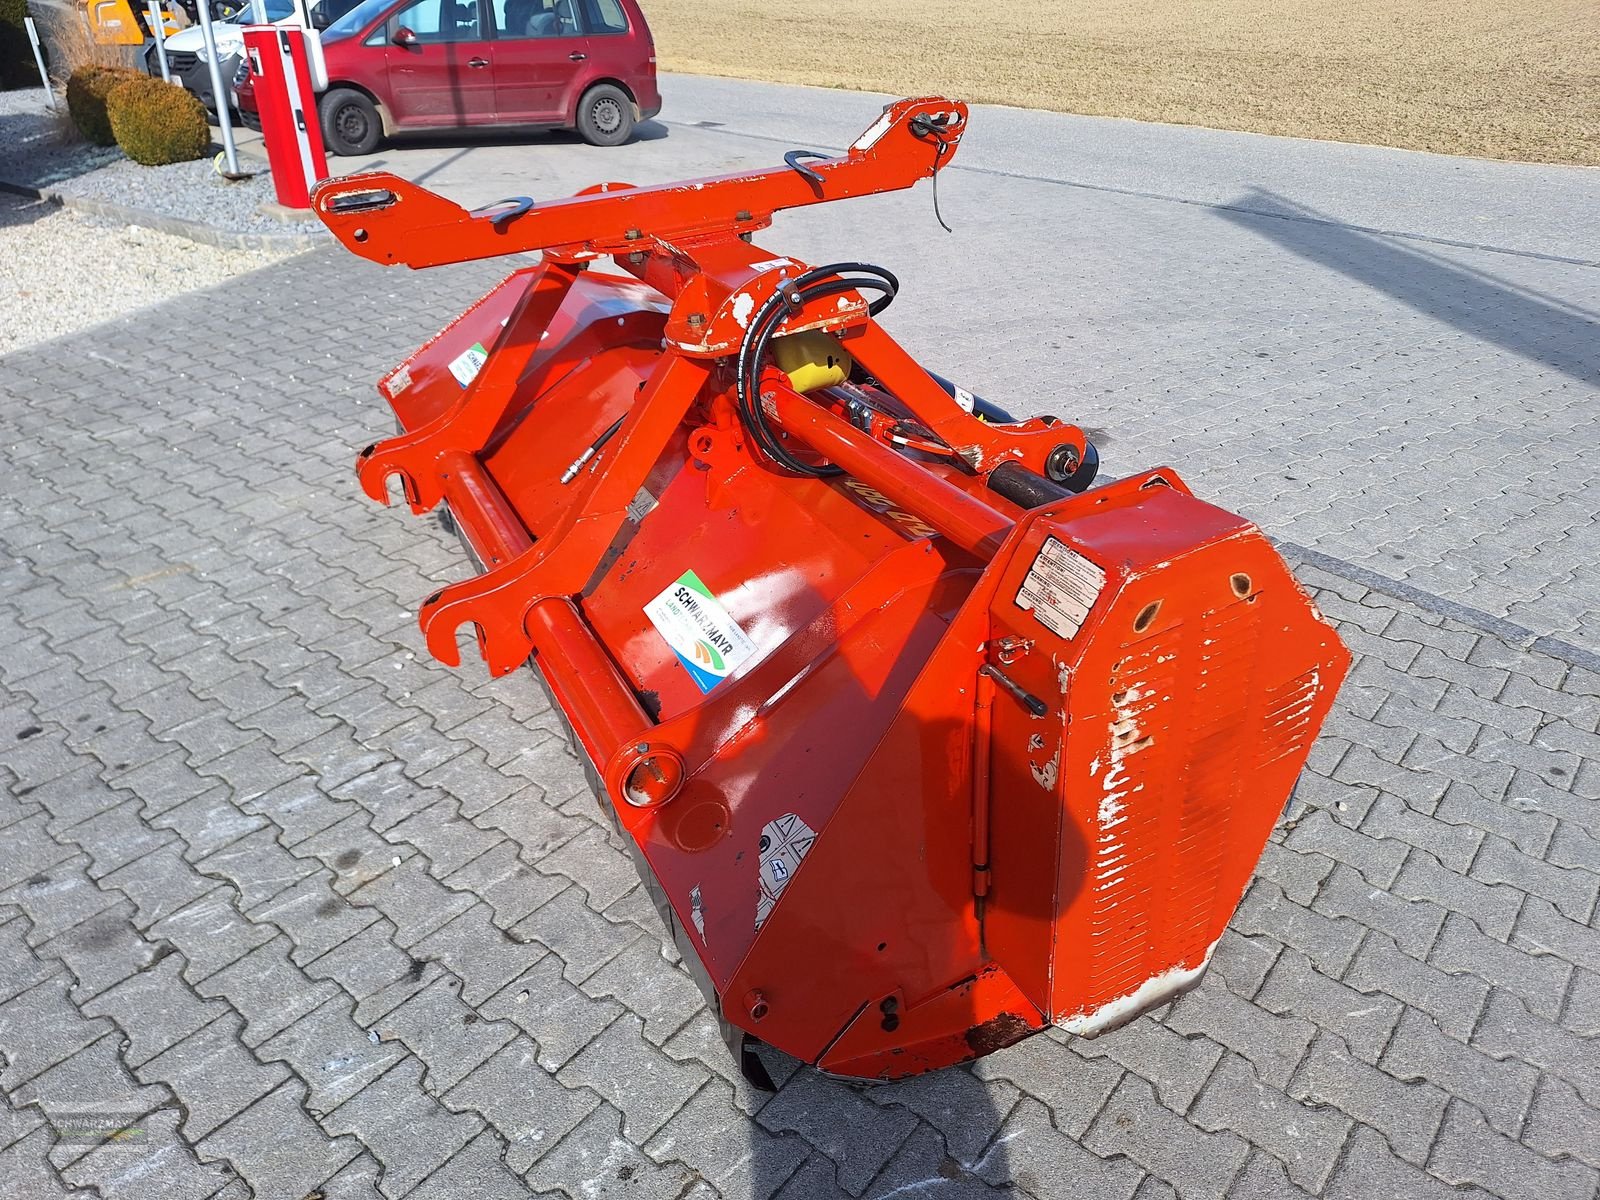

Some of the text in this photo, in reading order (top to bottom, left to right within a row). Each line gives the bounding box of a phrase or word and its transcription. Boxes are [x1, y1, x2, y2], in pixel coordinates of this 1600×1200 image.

[1030, 572, 1052, 589] WARNING!
[1022, 589, 1043, 606] ACHTUNG!
[675, 588, 733, 656] SCHWARZMAYR
